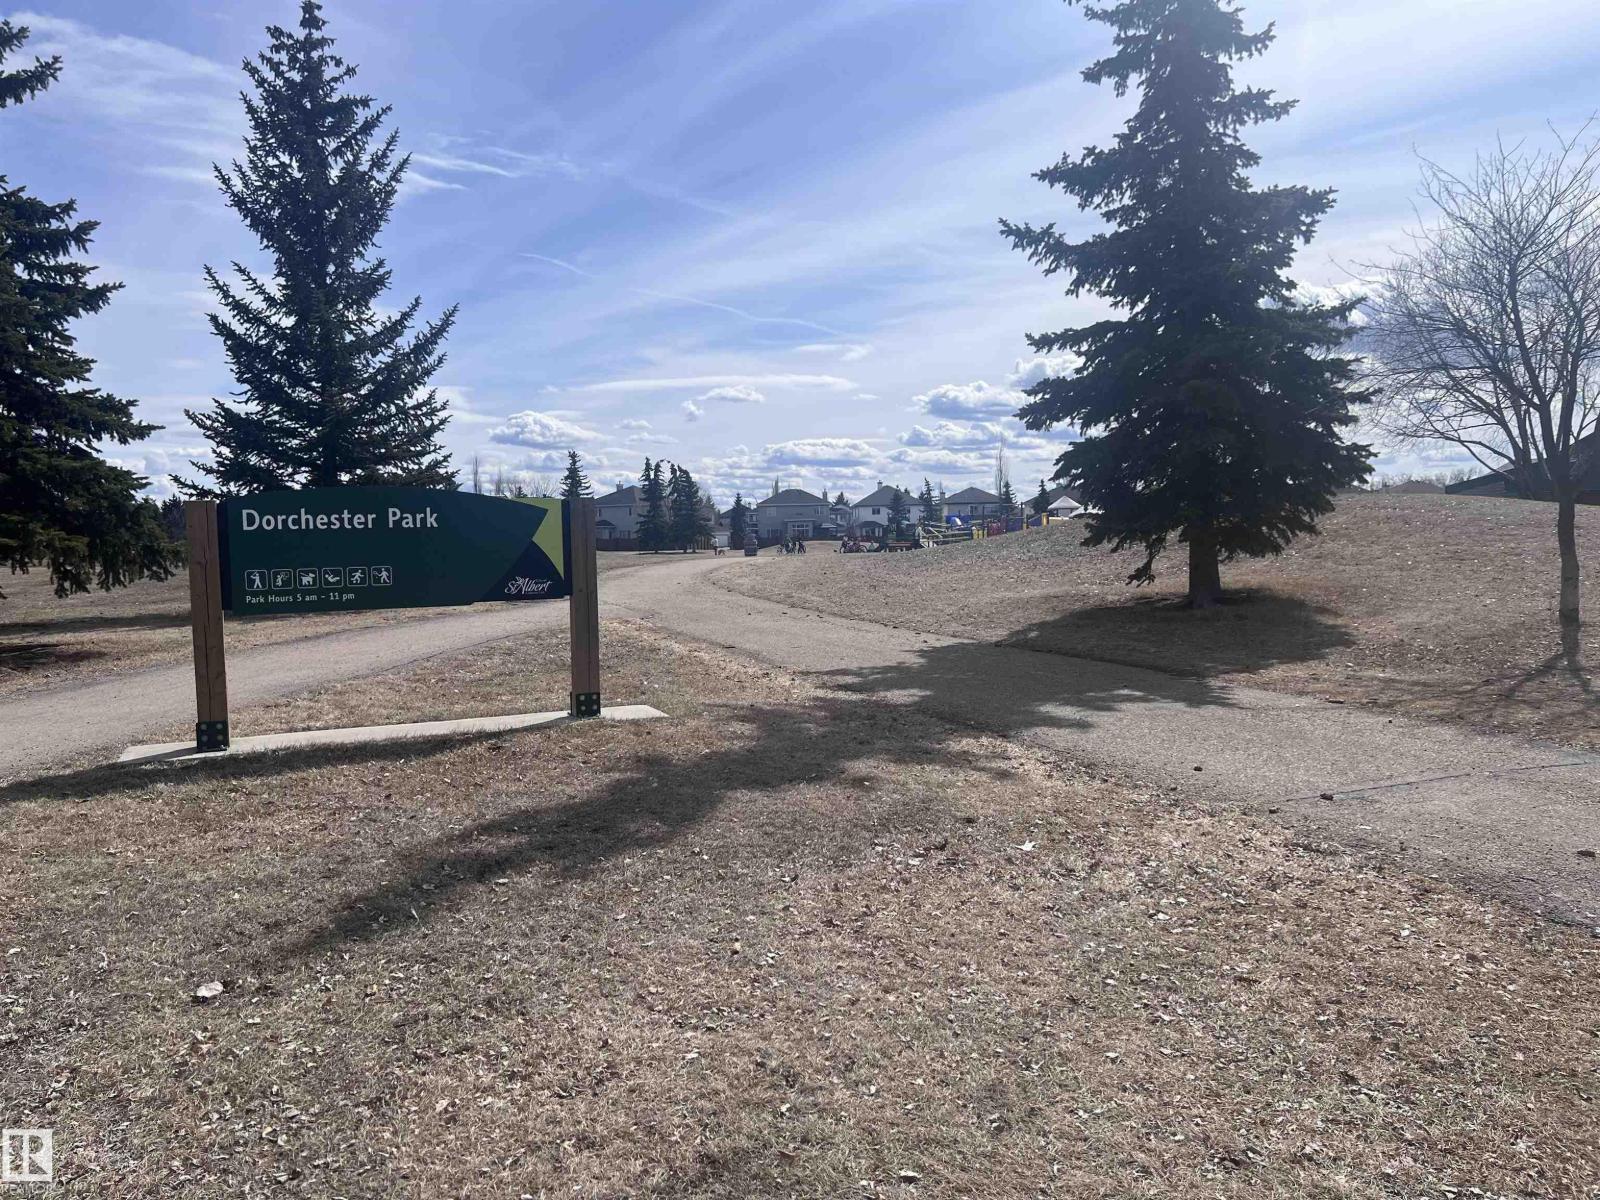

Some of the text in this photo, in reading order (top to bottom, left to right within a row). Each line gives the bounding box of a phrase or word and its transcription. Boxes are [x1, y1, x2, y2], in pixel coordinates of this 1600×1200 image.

[241, 507, 438, 531] Dorchester Park
[246, 595, 265, 603] Park
[268, 594, 293, 602] Hours
[296, 593, 302, 601] 5
[329, 592, 340, 600] 11
[342, 593, 355, 602] pm
